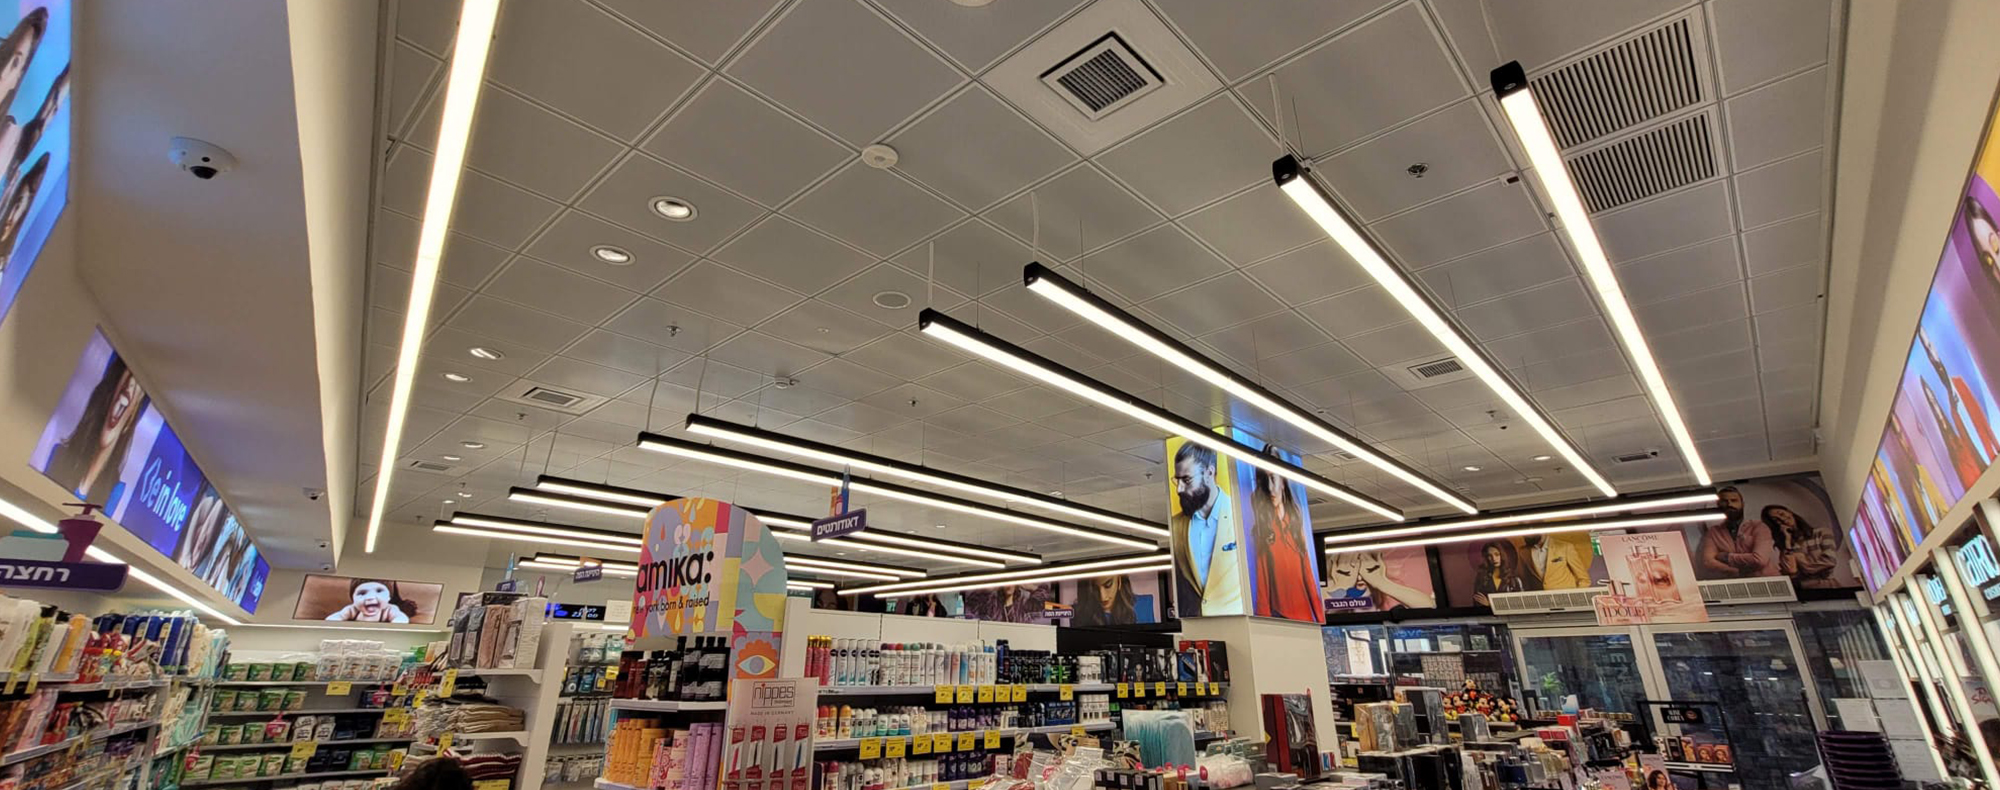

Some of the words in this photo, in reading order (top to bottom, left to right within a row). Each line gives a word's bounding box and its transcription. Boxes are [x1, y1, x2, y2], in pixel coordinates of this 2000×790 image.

[165, 481, 187, 531] love
[0, 563, 71, 582] רחצה
[645, 599, 659, 617] york
[661, 598, 677, 612] born
[678, 596, 684, 609] &
[685, 591, 710, 608] raised
[1349, 599, 1367, 607] עולם
[754, 683, 794, 706] nippes
